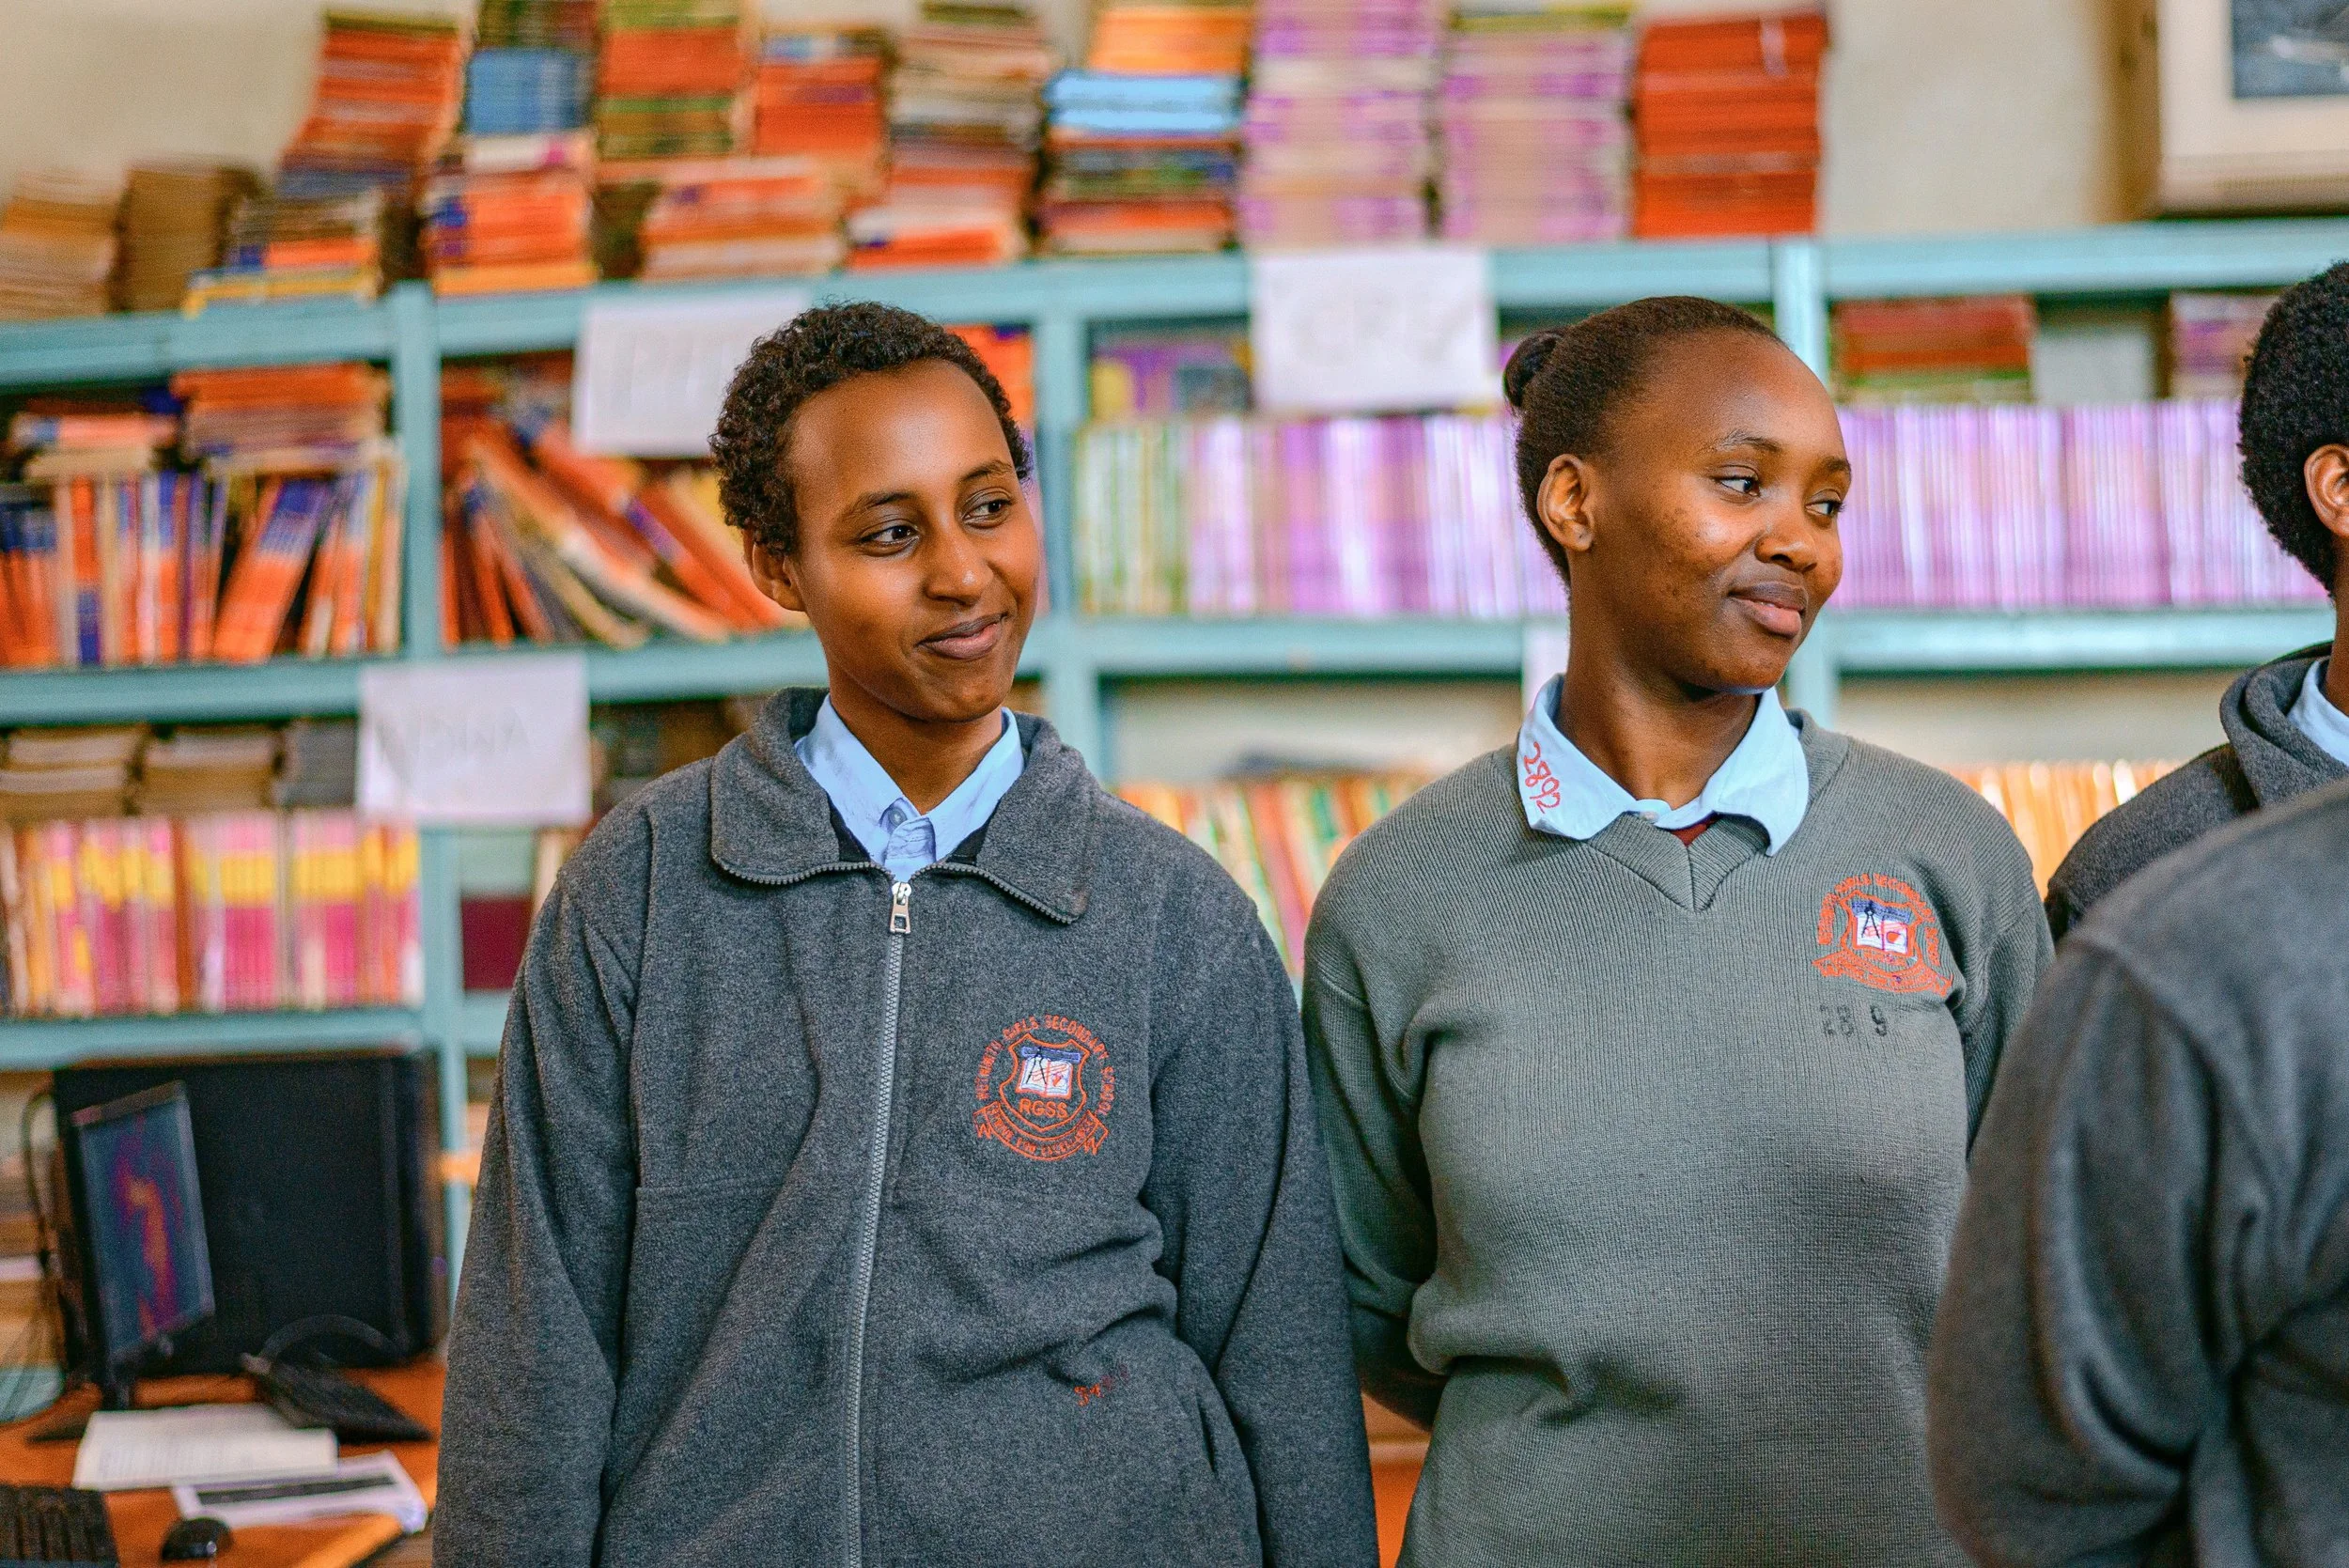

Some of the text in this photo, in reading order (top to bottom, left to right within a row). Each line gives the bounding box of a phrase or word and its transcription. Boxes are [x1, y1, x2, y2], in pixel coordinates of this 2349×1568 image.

[1523, 741, 1561, 814] 2892
[1044, 1014, 1110, 1060] SECONDARY
[1019, 1098, 1068, 1119] RGSS
